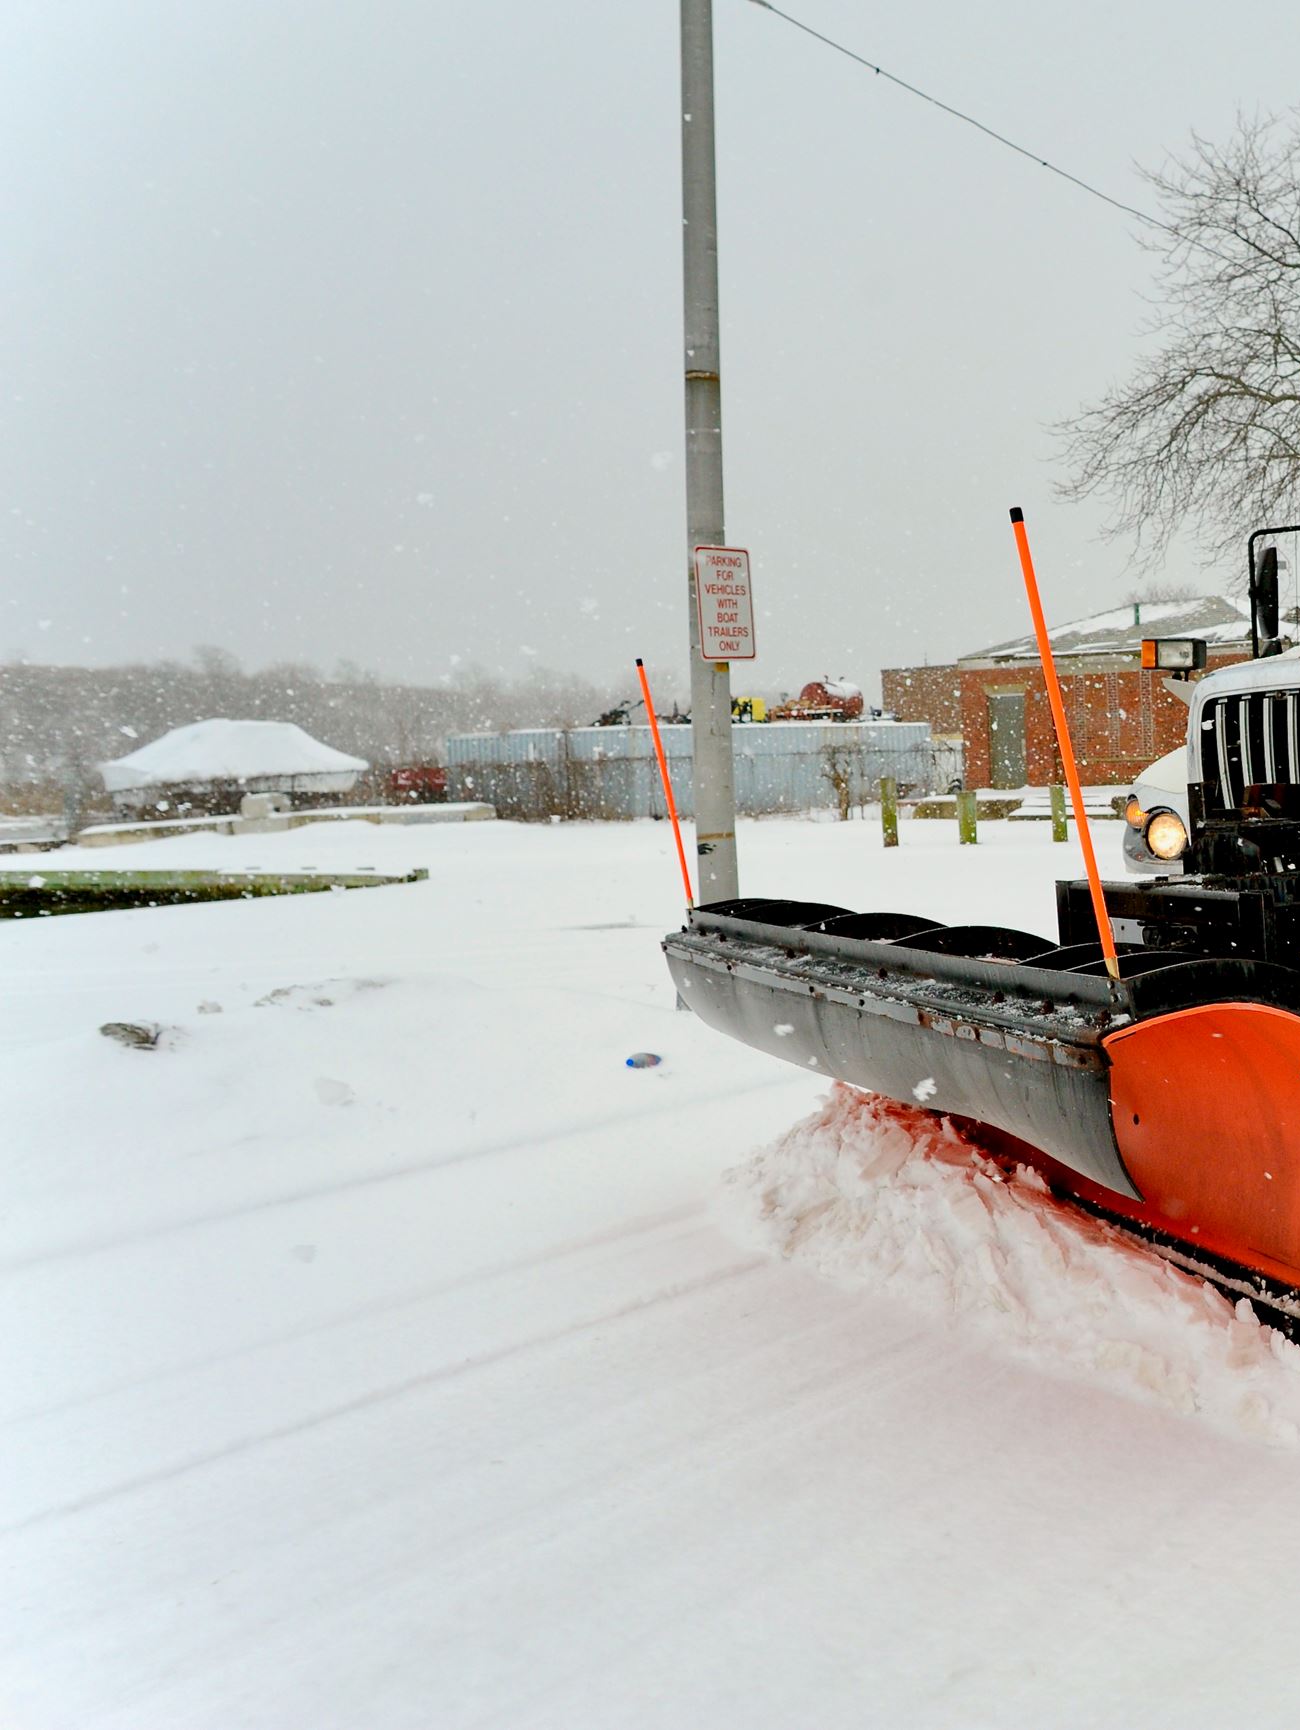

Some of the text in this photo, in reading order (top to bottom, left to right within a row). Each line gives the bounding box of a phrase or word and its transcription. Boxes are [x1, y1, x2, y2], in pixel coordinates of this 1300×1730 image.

[706, 555, 742, 568] PARKING
[716, 570, 734, 581] FOR
[704, 584, 746, 596] VEHICLES
[717, 599, 738, 609] WITH
[717, 613, 738, 623] BOAT
[707, 627, 749, 638] TRAILERS
[719, 641, 740, 652] ONLY
